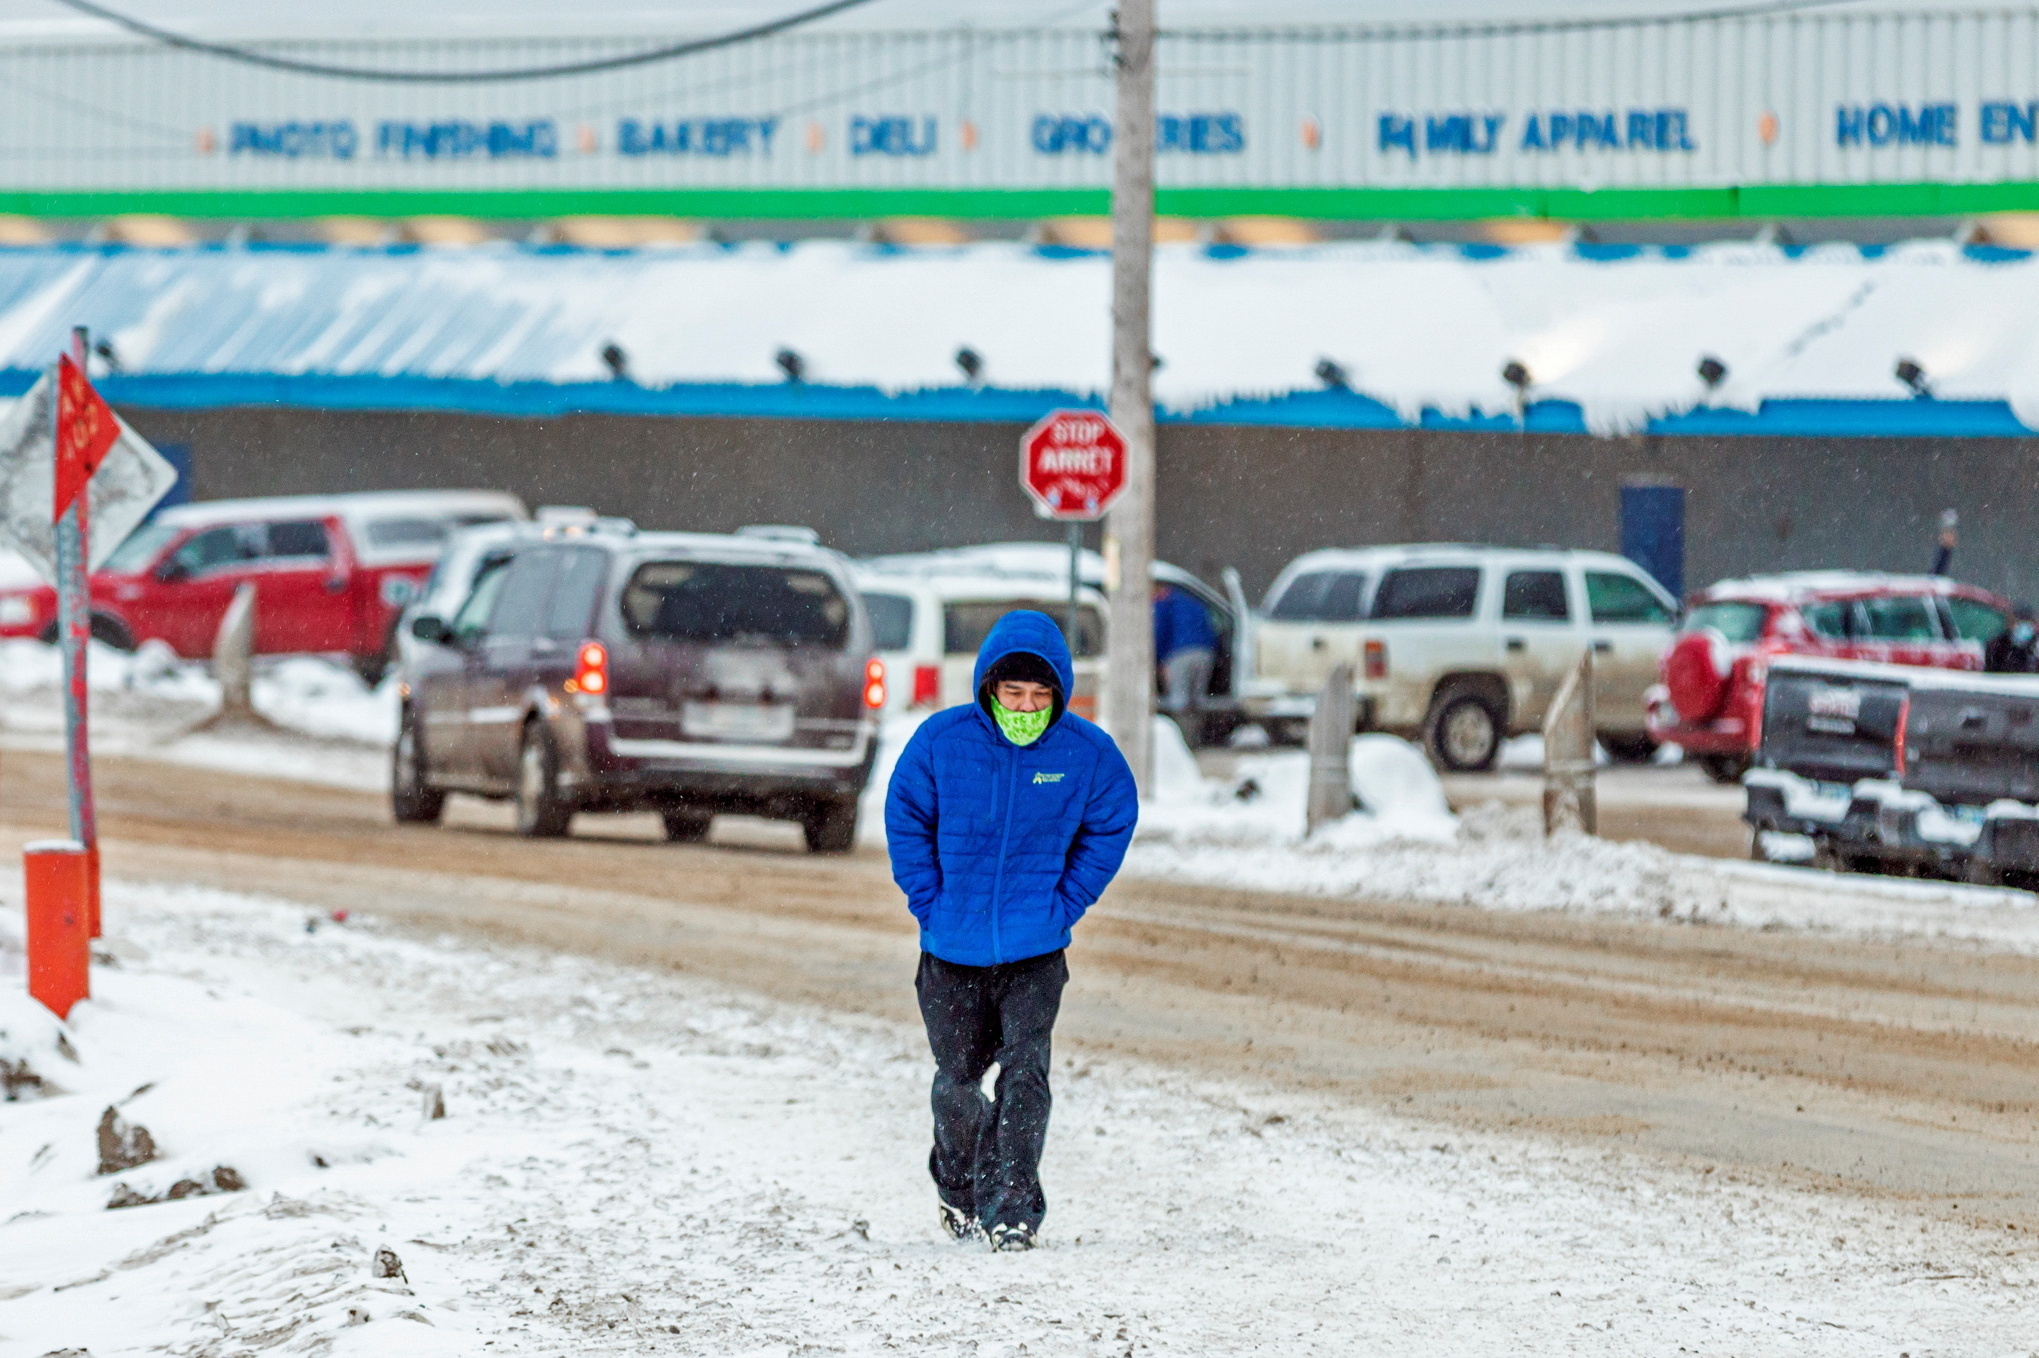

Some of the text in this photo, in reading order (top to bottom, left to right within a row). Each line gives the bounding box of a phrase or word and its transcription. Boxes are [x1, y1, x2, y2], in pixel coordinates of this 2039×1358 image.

[616, 116, 778, 159] BAKERY
[849, 114, 938, 158] DELI
[1520, 107, 1698, 153] APPAREL
[1834, 101, 1958, 148] HOME
[1050, 420, 1105, 444] STOP
